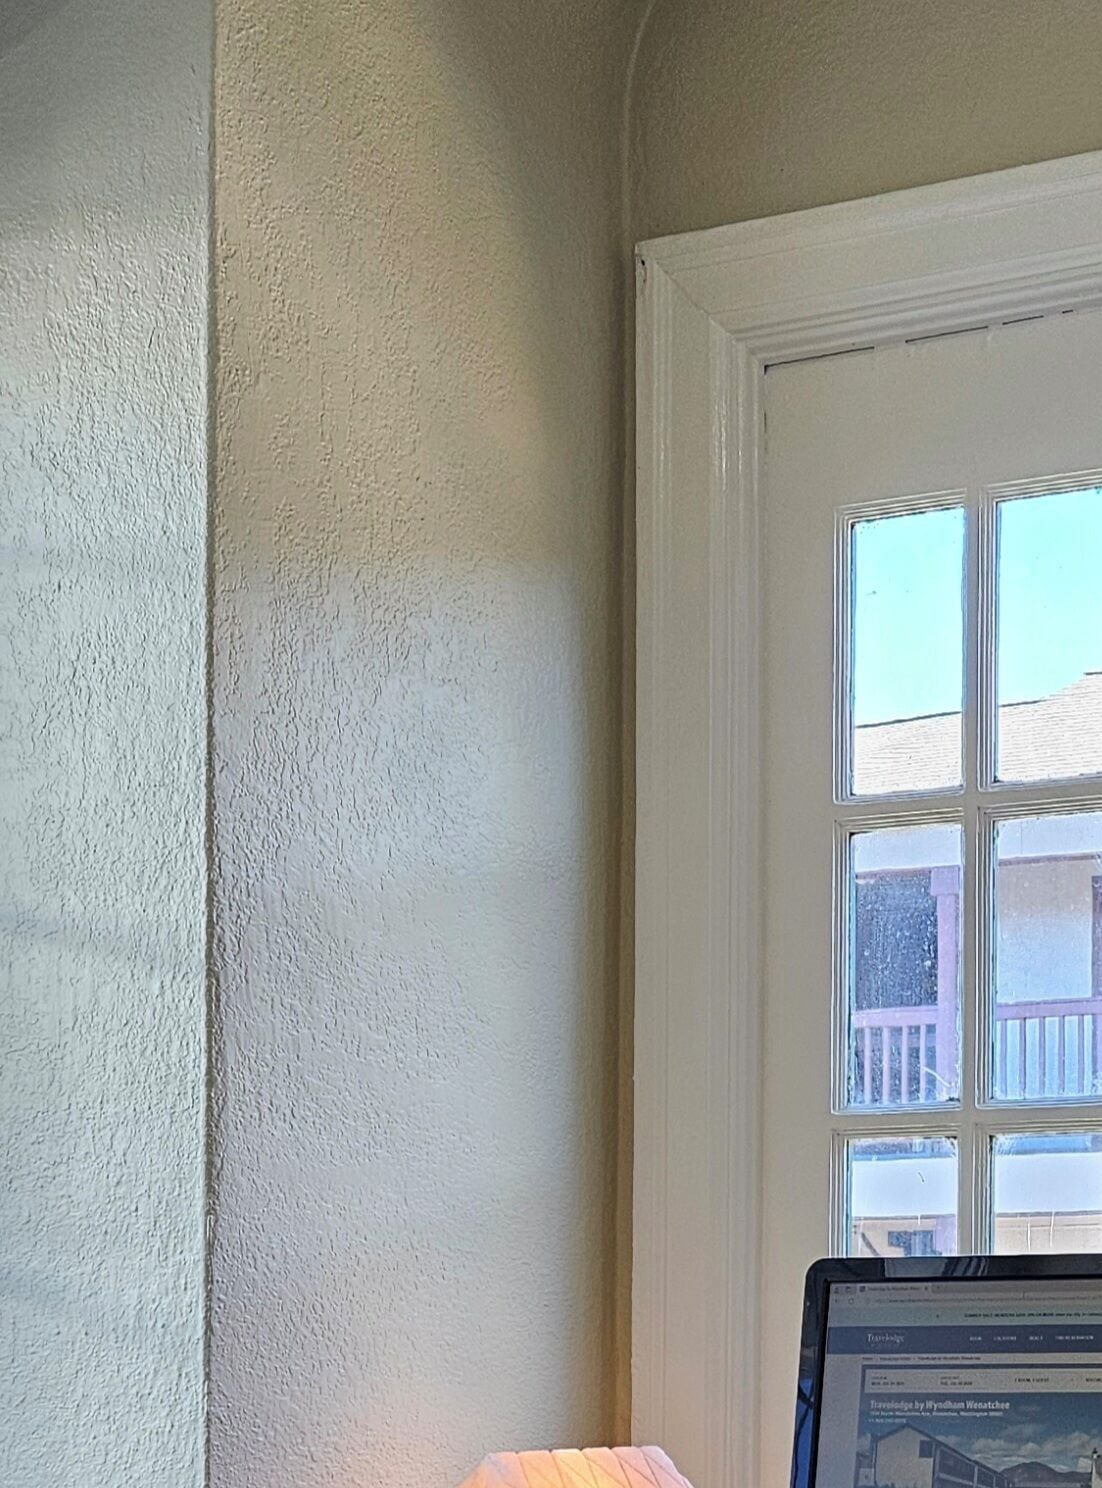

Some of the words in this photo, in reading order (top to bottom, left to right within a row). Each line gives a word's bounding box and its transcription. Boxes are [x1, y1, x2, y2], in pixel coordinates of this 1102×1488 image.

[870, 1400, 913, 1411] Travelodge
[914, 1400, 924, 1411] by
[925, 1400, 965, 1411] Wyndham
